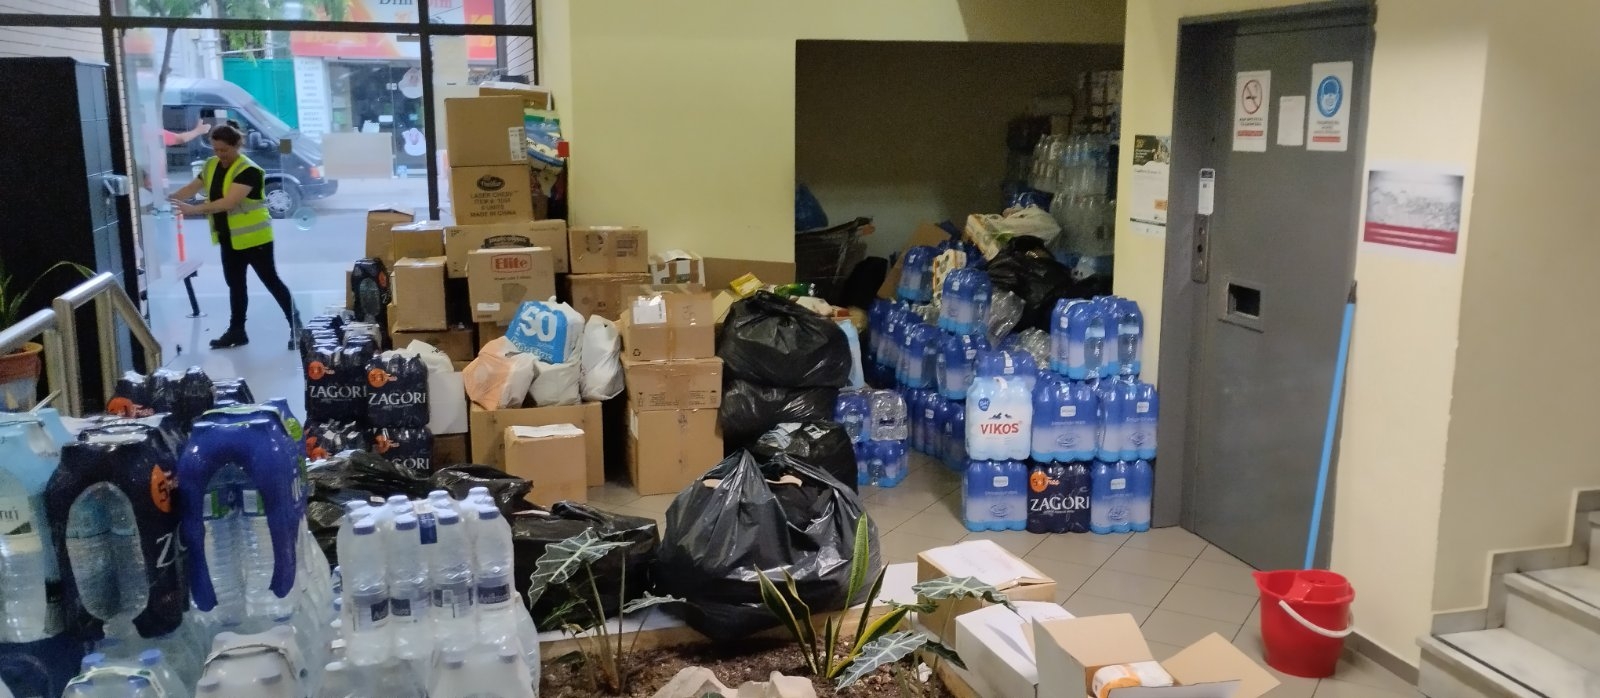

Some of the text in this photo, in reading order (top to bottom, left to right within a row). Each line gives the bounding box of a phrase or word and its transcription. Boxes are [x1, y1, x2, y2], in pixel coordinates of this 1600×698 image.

[495, 257, 528, 270] Elite
[520, 306, 558, 342] 50
[309, 385, 367, 398] ZAGORI
[368, 391, 426, 405] ZAGORI
[981, 423, 1019, 435] VIKOS
[1030, 496, 1090, 511] ZAGORI
